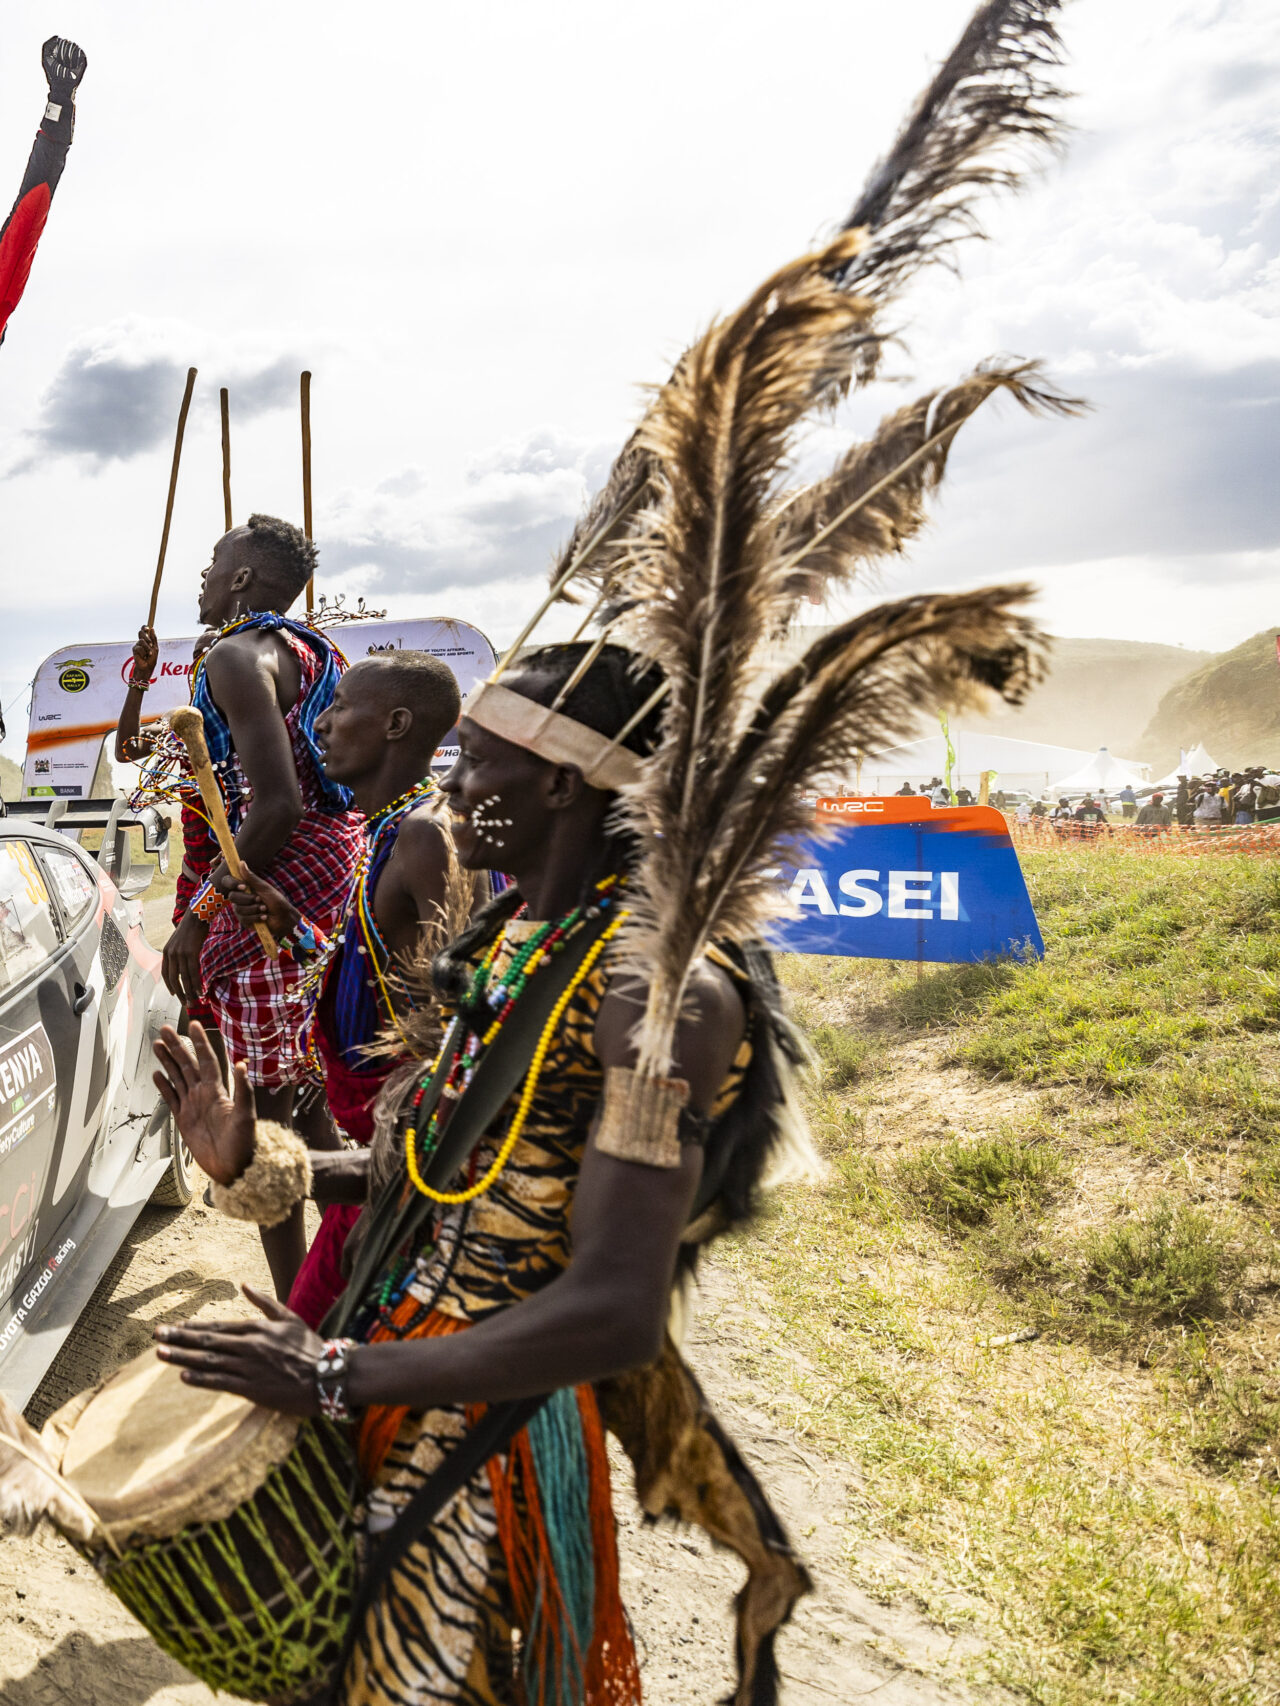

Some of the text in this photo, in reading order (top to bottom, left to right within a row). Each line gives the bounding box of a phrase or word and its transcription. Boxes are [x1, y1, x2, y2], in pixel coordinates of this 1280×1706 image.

[38, 713, 62, 722] WRC
[823, 801, 884, 813] WRC
[6, 841, 48, 905] 33
[22, 1268, 54, 1311] GAZOO
[47, 1237, 77, 1272] Racing
